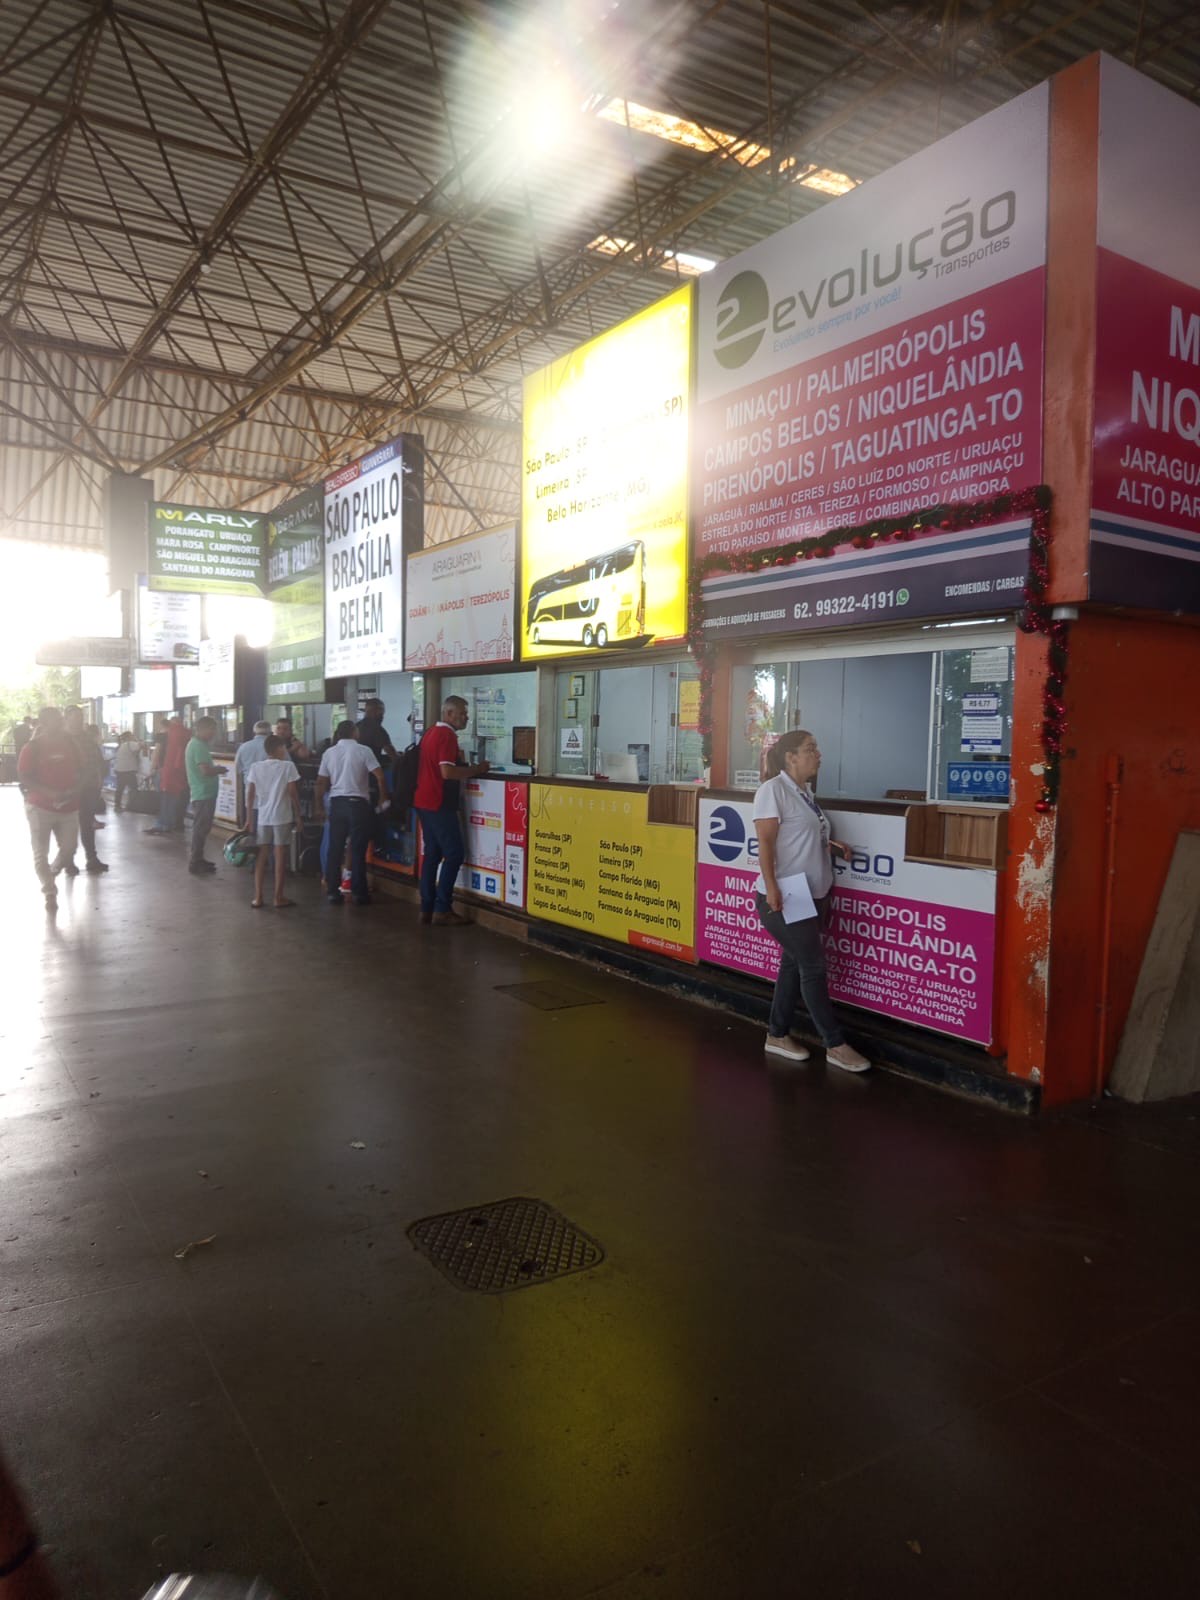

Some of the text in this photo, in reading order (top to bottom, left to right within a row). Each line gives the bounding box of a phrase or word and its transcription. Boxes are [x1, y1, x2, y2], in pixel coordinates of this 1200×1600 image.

[773, 190, 1016, 334] evolução
[933, 237, 1010, 279] Transportes
[726, 309, 985, 431] MINAÇU PALMEIRÓPOLIS
[704, 342, 1024, 472] CAMPOS BELOS NIQUELÂNDIA
[703, 388, 1023, 506] PIRENÓPOLIS TAGUATINGA-TO
[702, 452, 1024, 542] ESTRELA DO NORTE STA. TEREZA FORMOSO CAMPINAÇU
[703, 432, 1023, 527] JARAGUÁ RIALMA CERES SÃO LUÍZ DO NORTE URUAÇU
[1117, 477, 1165, 509] ALTO
[155, 508, 259, 528] MARLY
[165, 526, 215, 539] PORANGATU
[326, 472, 399, 544] SÃO PAULO
[547, 505, 567, 523] Belo
[731, 530, 769, 549] PARAÍSO
[776, 521, 811, 539] MONTE
[812, 510, 856, 531] ALEGRE
[865, 492, 940, 520] COMBINADO
[949, 476, 1010, 502] AURORA
[156, 537, 261, 556] MARA ROSA CAMPINORTE
[157, 548, 173, 559] SÃO
[173, 551, 205, 562] MIGUEL
[207, 554, 219, 564] DO
[162, 562, 200, 575] SANTANA
[201, 565, 214, 576] DO
[332, 533, 393, 592] BRASÍLIA
[339, 585, 383, 640] BELÉM
[753, 612, 760, 622] DE
[793, 601, 812, 619] 62.
[815, 590, 895, 616] 99322-4191
[945, 576, 1025, 597] ENCOMENDAS CARGAS
[599, 854, 635, 871] Limeira (SP)
[612, 842, 629, 853] Paulo
[630, 845, 643, 857] (SP)
[598, 885, 623, 899] Santana
[634, 892, 665, 907] Araguaia
[666, 899, 681, 913] (PA)
[644, 878, 660, 892] (MG)
[724, 875, 947, 932] MINA MEIRÓPOLIS
[582, 910, 595, 923] (TO)
[598, 900, 623, 915] Formoso
[633, 909, 665, 925] Araguaia
[666, 917, 681, 931] (TO)
[705, 889, 977, 963] CAMPO NIQUELÂNDIA
[704, 931, 737, 945] ESTRELA
[738, 940, 750, 948] DO
[751, 943, 780, 956] NORTE
[849, 970, 900, 989] FORMOSO
[908, 985, 977, 1010] CAMPINAÇU
[705, 924, 740, 938] JARAGUÁ
[746, 934, 775, 947] RIALMA
[863, 963, 878, 974] DO
[881, 967, 917, 984] NORTE
[926, 979, 976, 999] URUAÇU
[710, 941, 966, 1017] ALTO PARAÍSO COMBINADO AURORA
[819, 933, 977, 985] TAGUATINGA-TO
[711, 948, 732, 959] NOVO
[733, 954, 765, 969] ALEGRE
[833, 983, 883, 1003] CORUMBÁ
[891, 999, 964, 1027] PLANALMIRA
